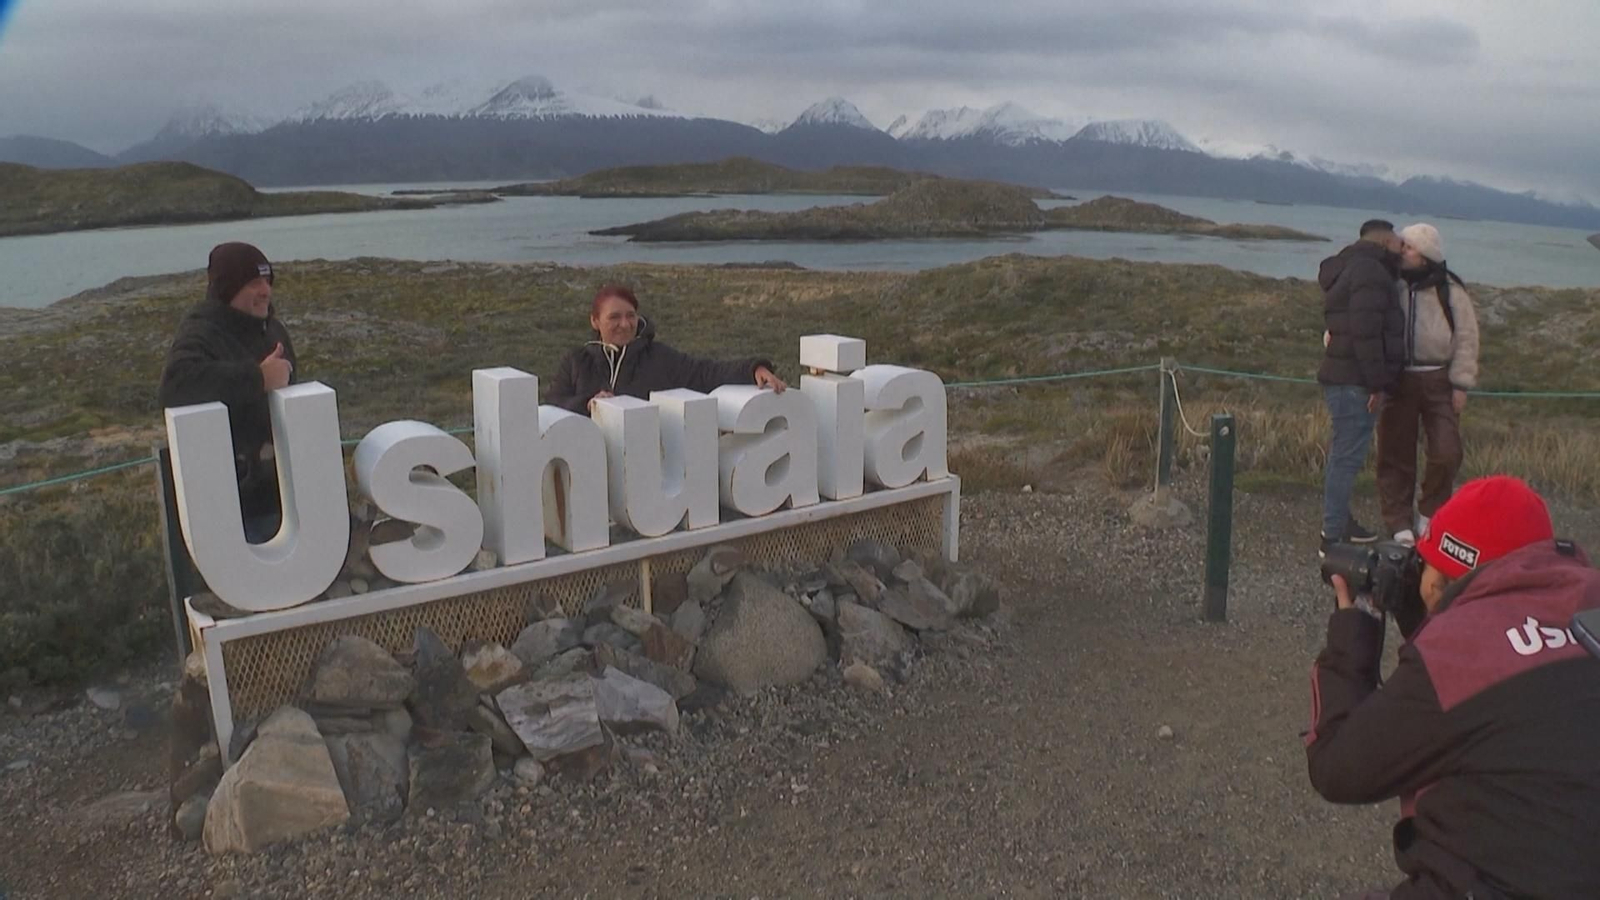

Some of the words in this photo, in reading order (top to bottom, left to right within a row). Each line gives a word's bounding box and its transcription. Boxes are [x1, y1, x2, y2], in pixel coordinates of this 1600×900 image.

[165, 334, 949, 611] Ushuaia
[1442, 537, 1475, 564] FOTOS
[1505, 615, 1578, 656] Us
